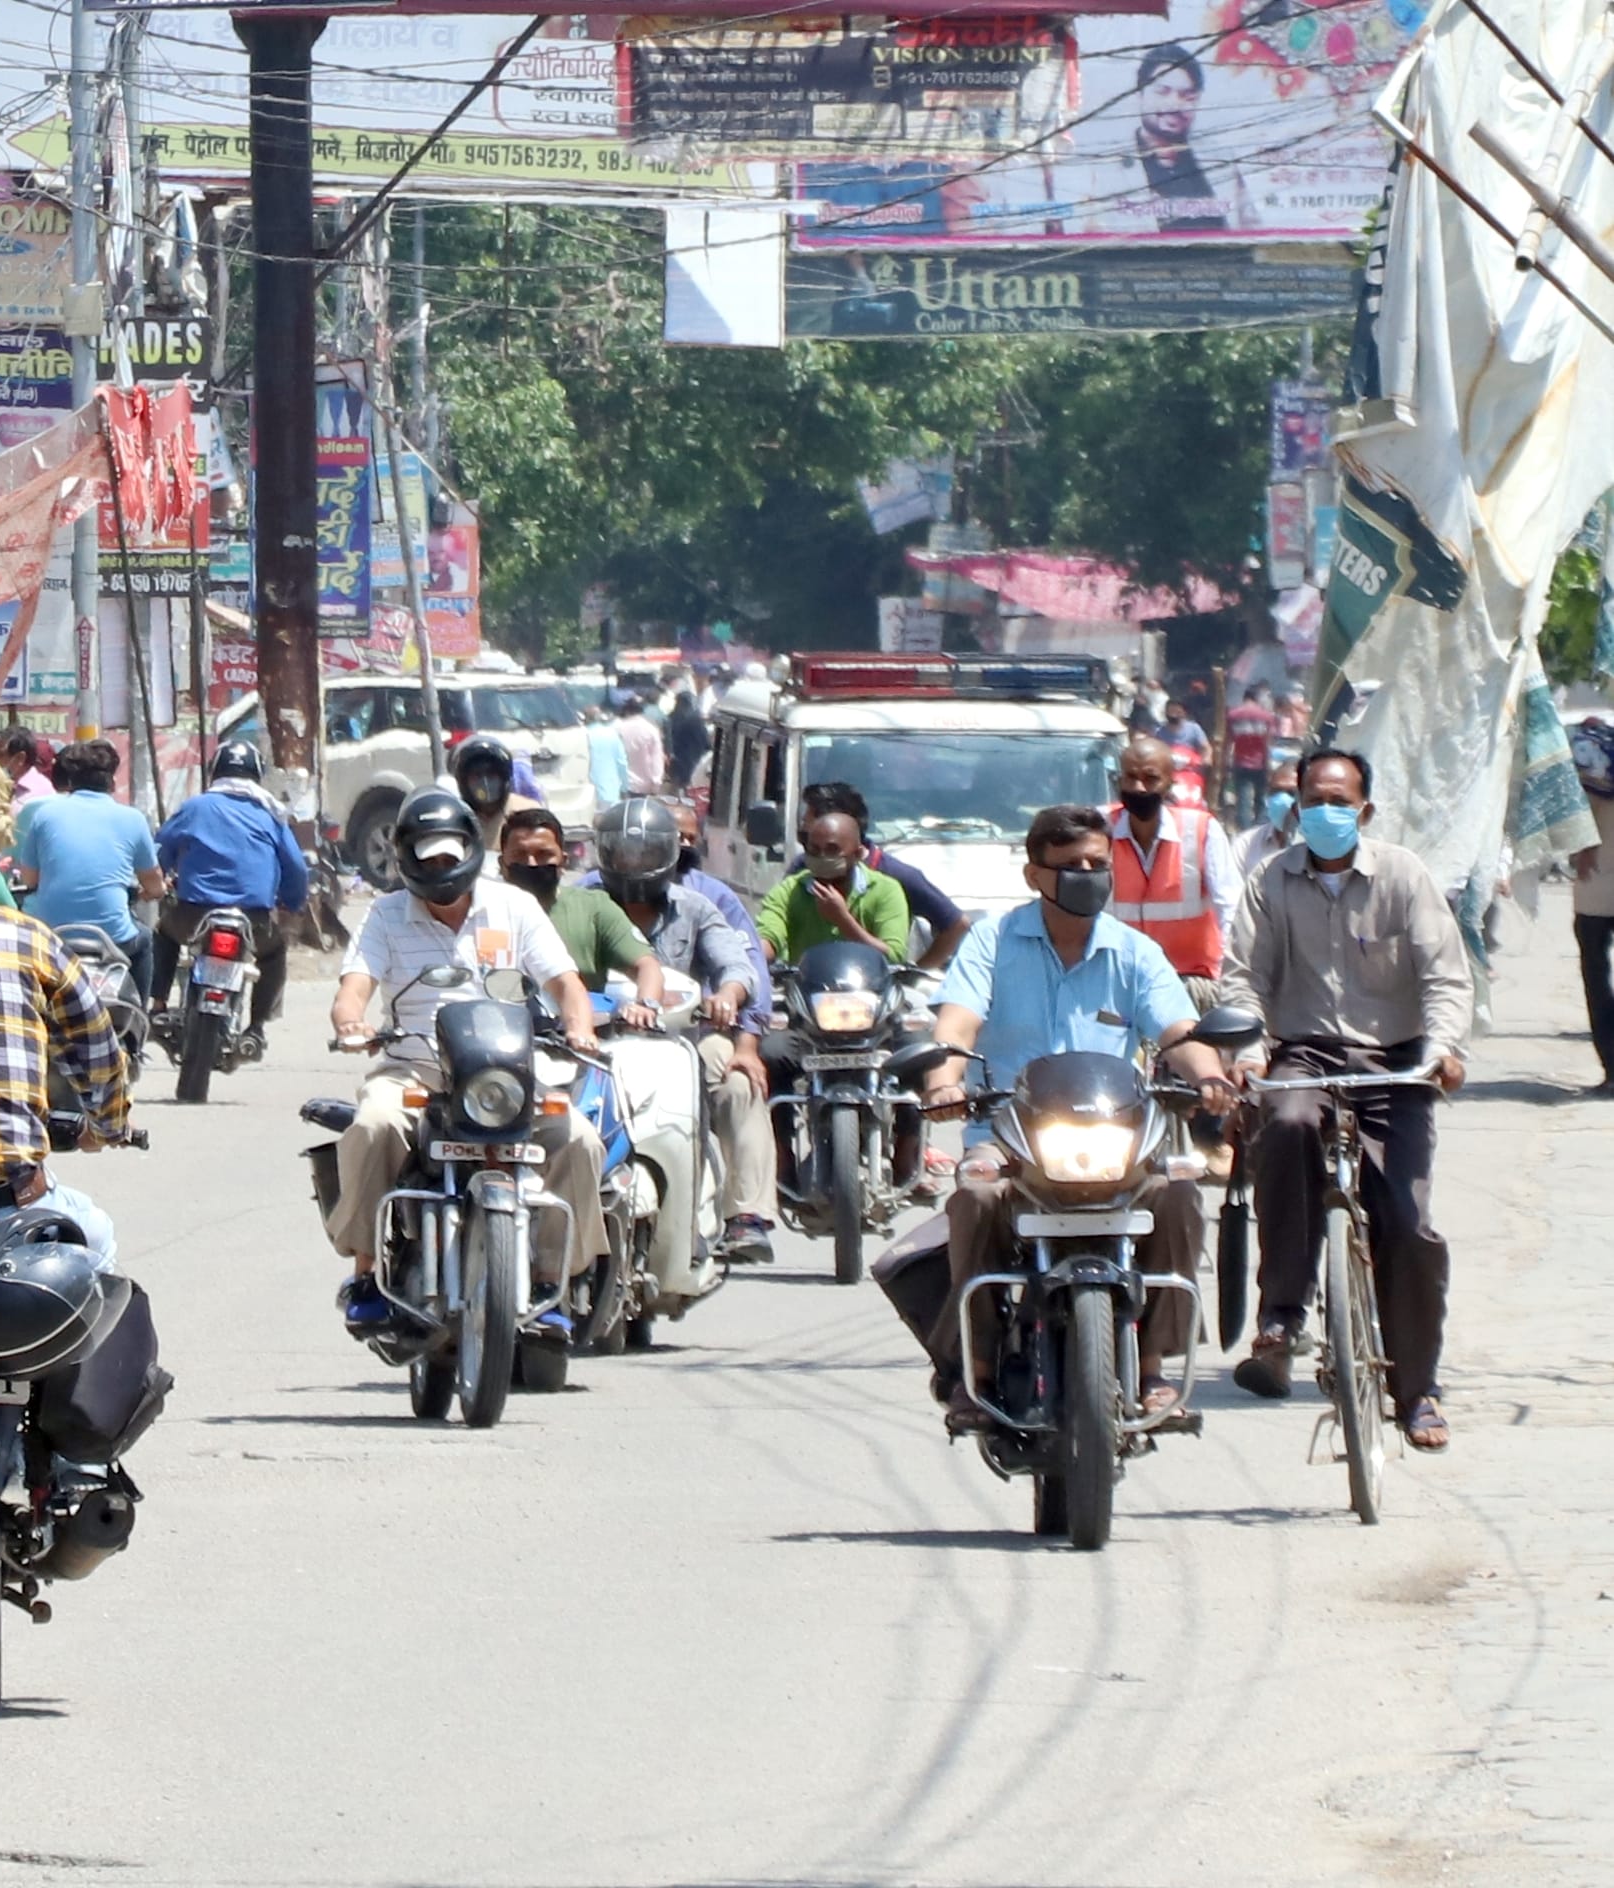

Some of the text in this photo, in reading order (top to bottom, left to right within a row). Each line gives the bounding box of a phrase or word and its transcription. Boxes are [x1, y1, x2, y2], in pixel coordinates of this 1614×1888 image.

[873, 47, 1052, 64] VISION POINT
[910, 256, 1084, 311] Uttam
[915, 311, 965, 333] Color
[969, 311, 1002, 332] Lab
